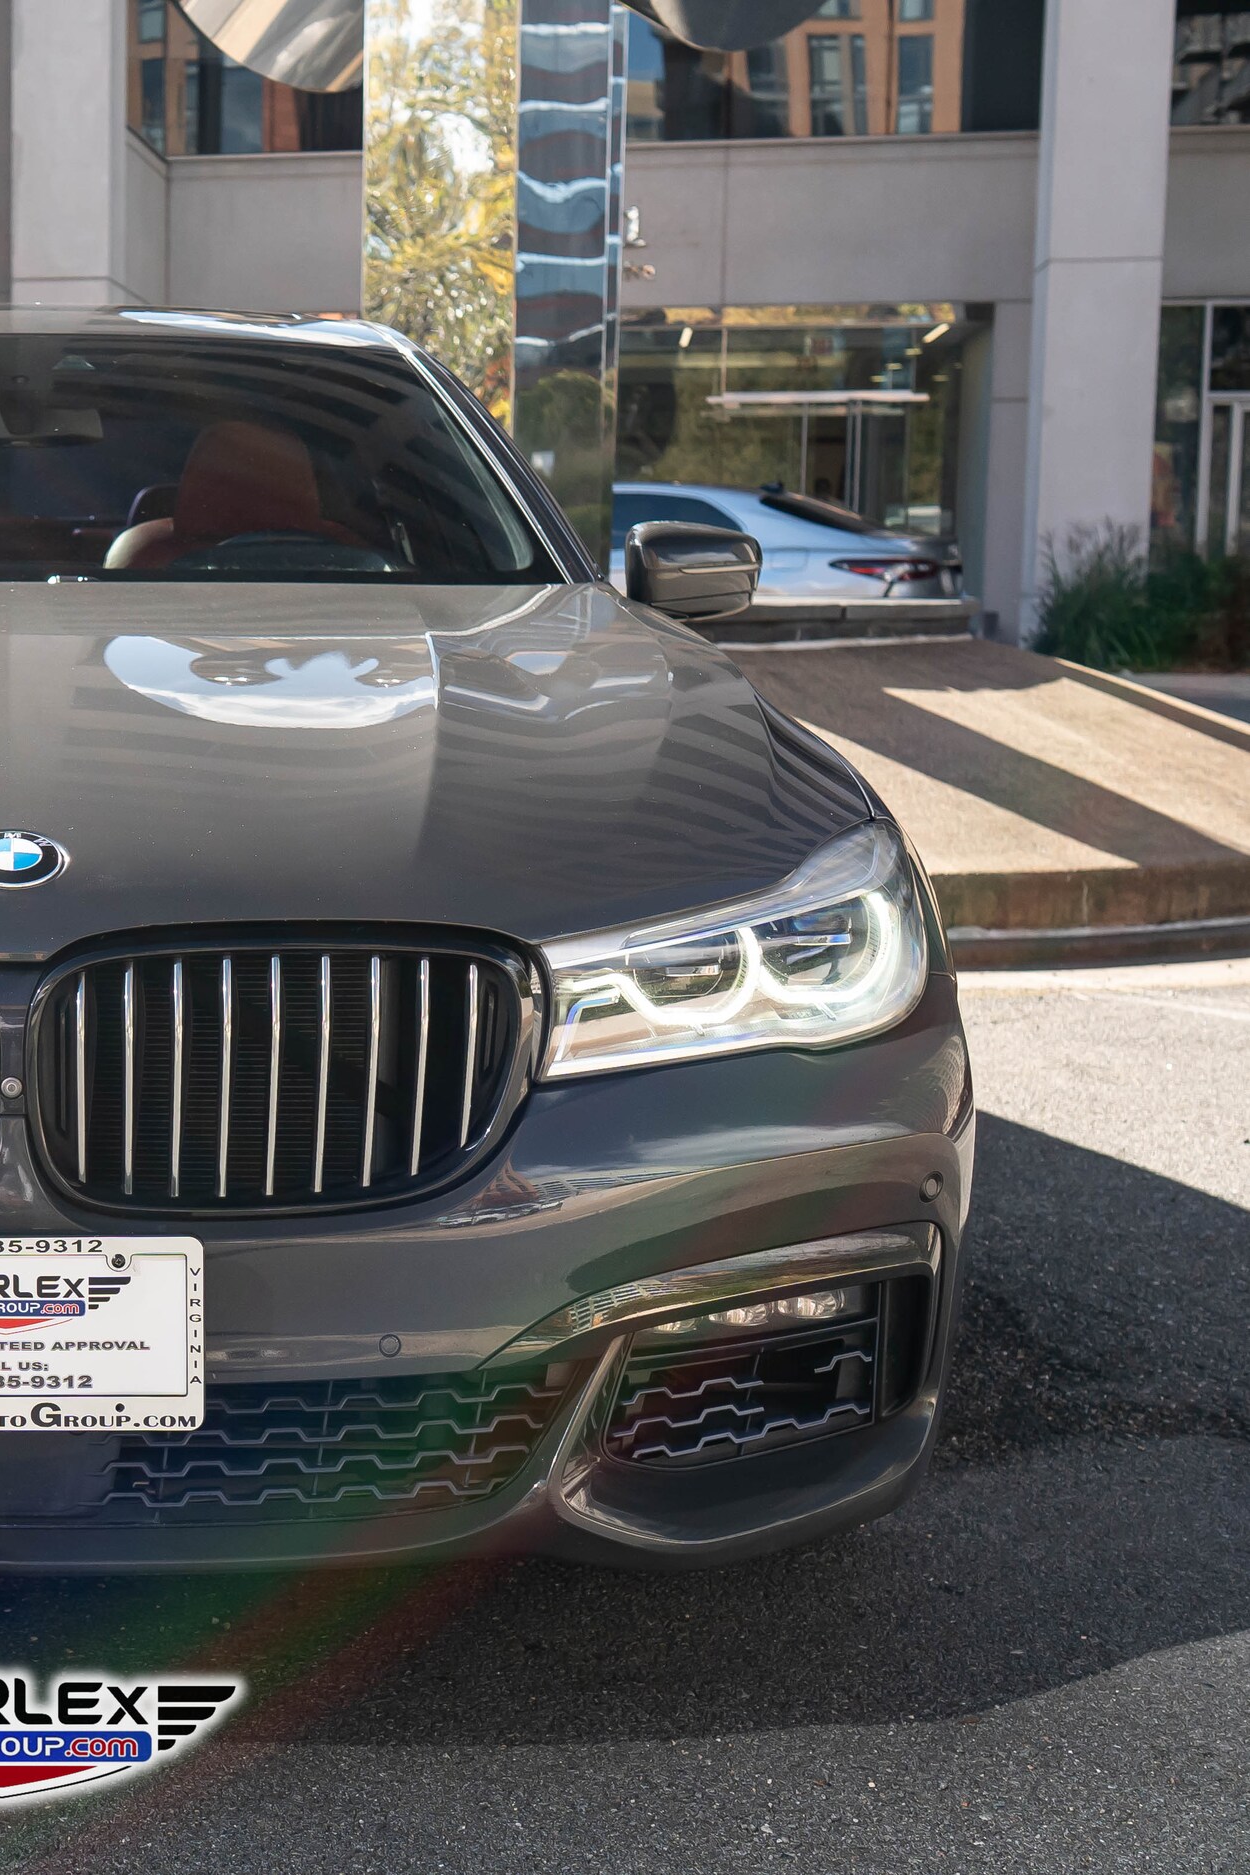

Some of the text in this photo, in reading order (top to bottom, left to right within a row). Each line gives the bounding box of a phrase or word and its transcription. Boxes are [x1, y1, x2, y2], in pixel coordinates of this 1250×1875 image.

[189, 1268, 202, 1384] VIRGINIA
[51, 1340, 150, 1351] APPROVAL
[18, 1361, 49, 1371] US:
